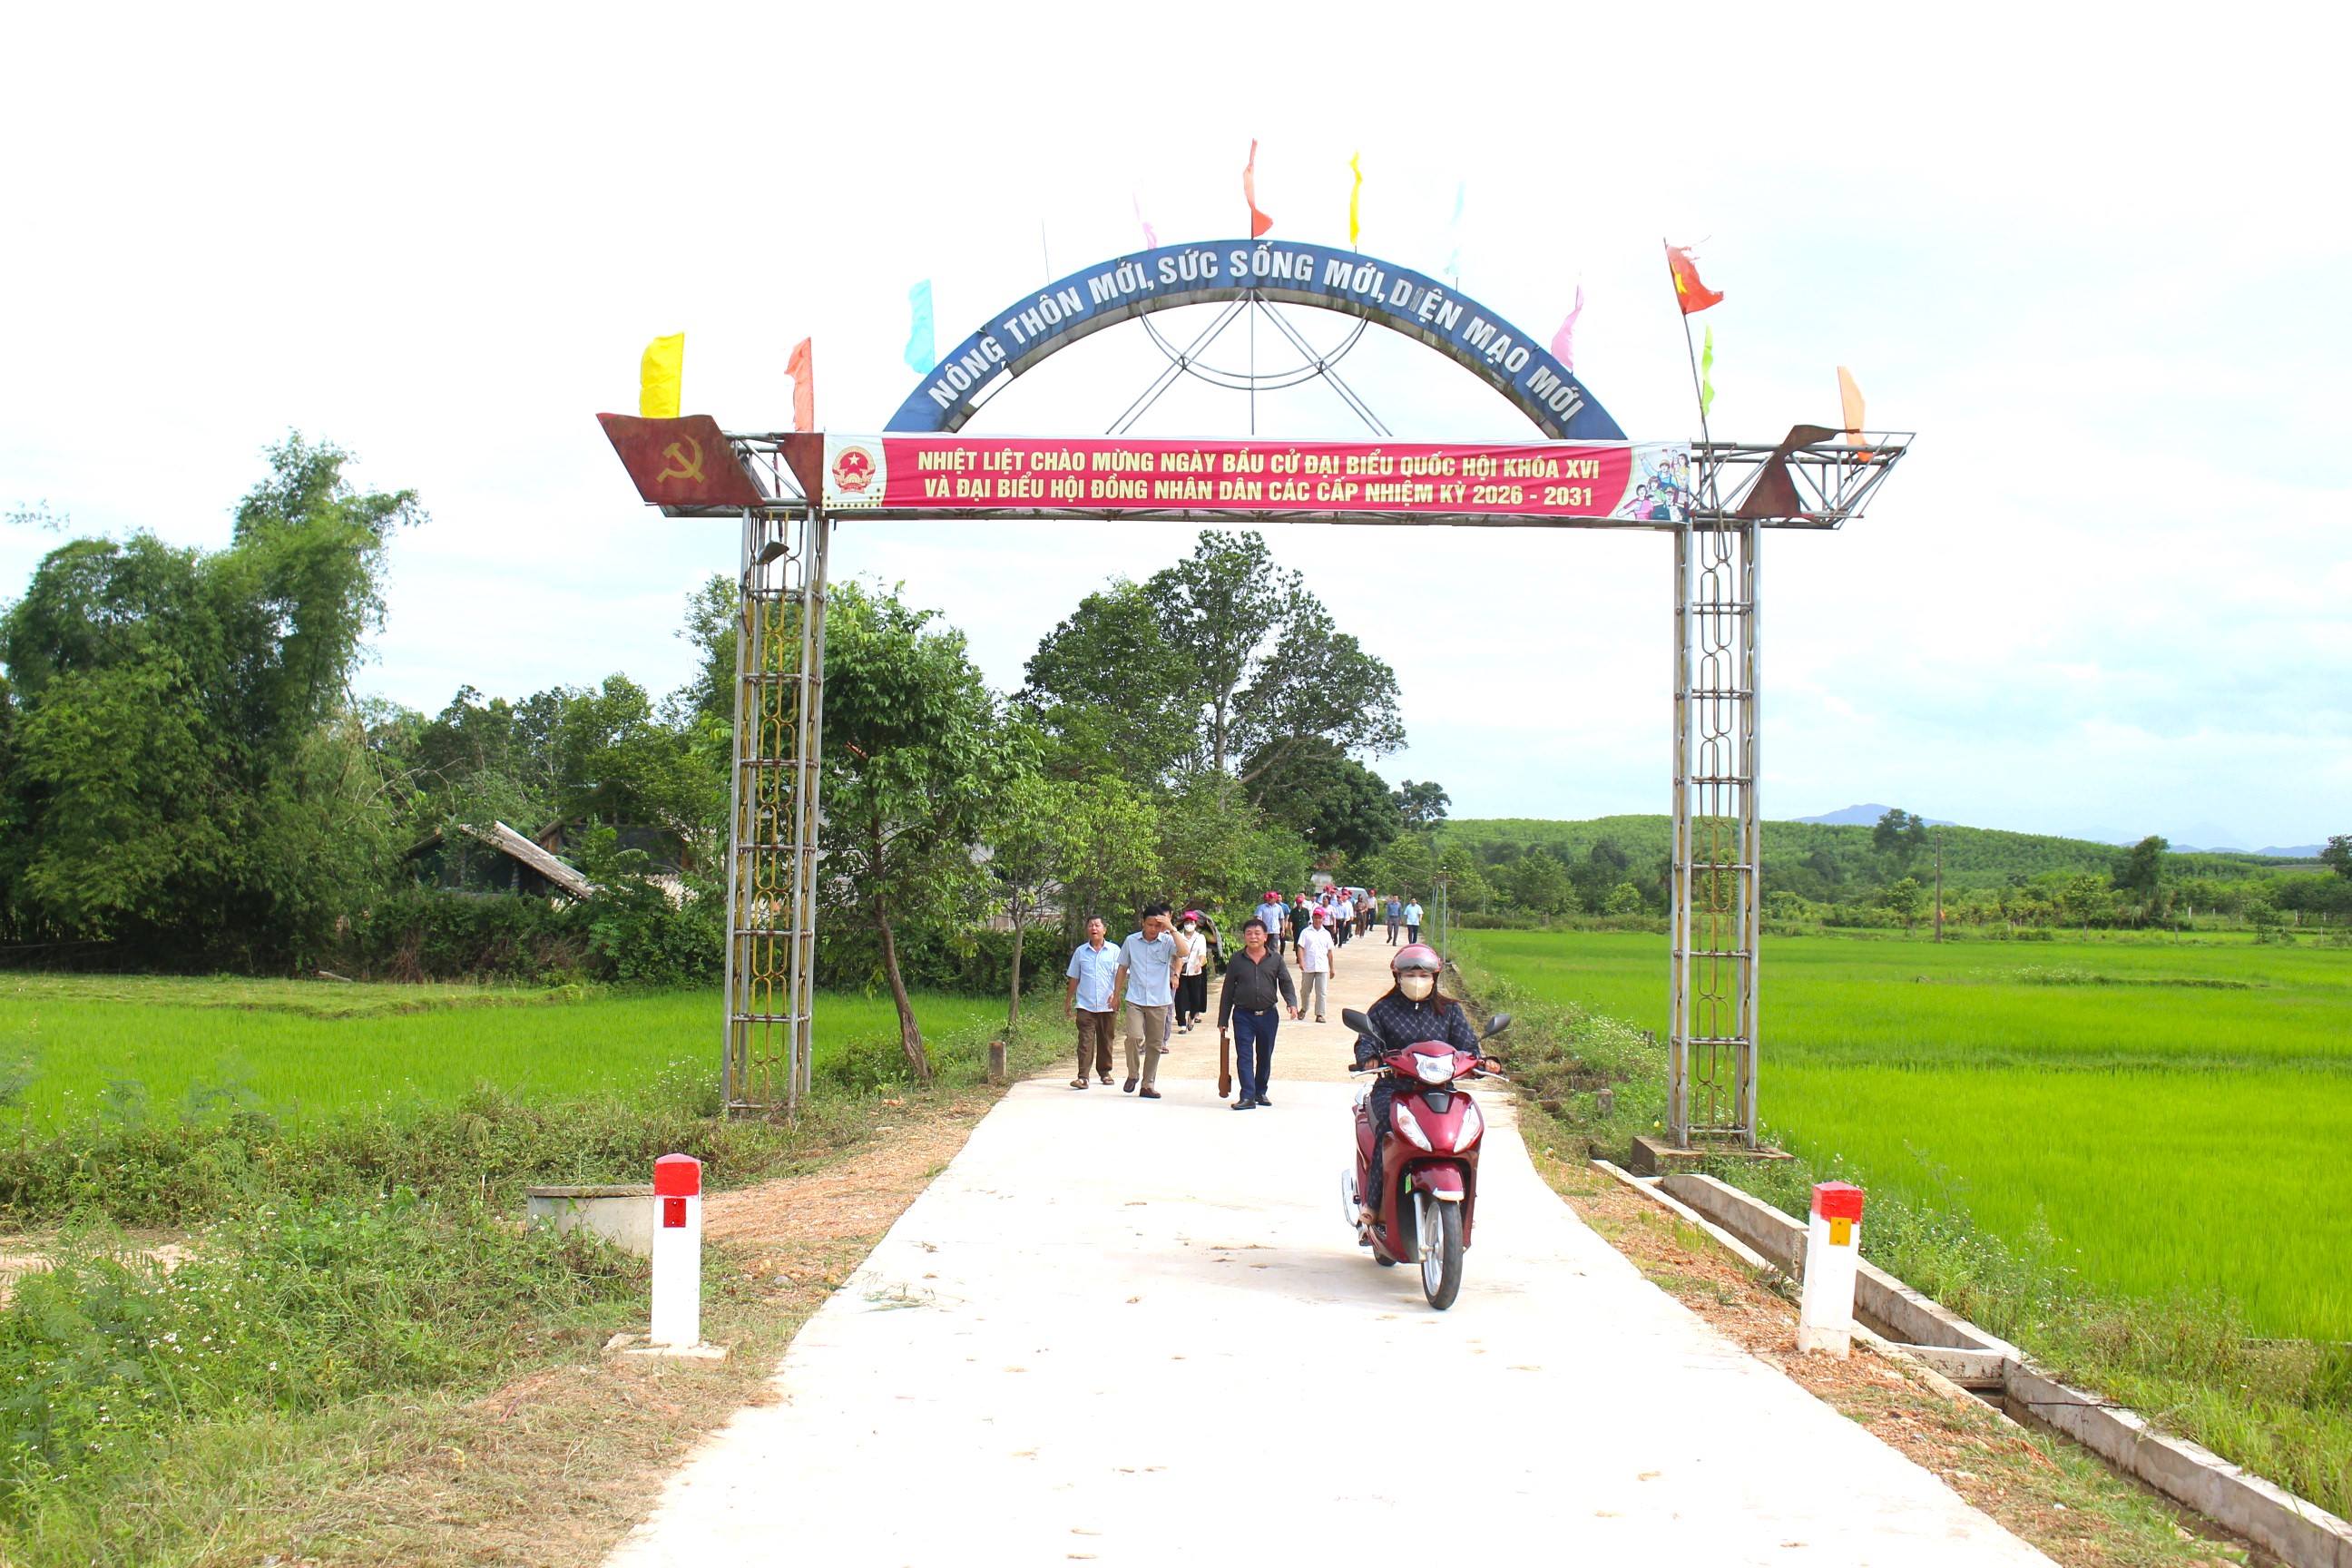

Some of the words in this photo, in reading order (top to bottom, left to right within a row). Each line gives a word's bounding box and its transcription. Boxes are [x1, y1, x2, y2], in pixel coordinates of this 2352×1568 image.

[927, 336, 1006, 409] NÔNG
[1004, 287, 1084, 345] THÔN
[1088, 258, 1154, 305] MỚI,
[1158, 248, 1218, 284] SỨC
[1230, 240, 1314, 281] SỐNG
[1323, 259, 1385, 302] MỚI,
[1389, 278, 1465, 331] DIỆN
[1463, 317, 1530, 373] MẠO
[1525, 365, 1584, 422] MỚI
[918, 447, 977, 475] NHIỆT
[983, 447, 1024, 475] LIỆT
[1031, 447, 1085, 471] CHÀO
[1092, 448, 1154, 472] MỪNG
[1161, 449, 1216, 473] NGÀY
[1222, 447, 1264, 473] BẦU
[1270, 448, 1301, 474] CỬ
[1305, 455, 1339, 478] ĐẠI
[1347, 448, 1394, 475] BIỂU
[1400, 450, 1455, 477] QUỐC
[1462, 455, 1497, 481] HỘI
[1504, 456, 1559, 478] KHÓA
[1565, 459, 1600, 479] XVI
[925, 475, 951, 497] VÀ
[956, 478, 991, 502] ĐẠI
[997, 471, 1044, 497] BIỂU
[1050, 475, 1084, 503] HỘI
[1091, 473, 1148, 498] ĐỒNG
[1154, 476, 1212, 500] NHÂN
[1219, 477, 1262, 501] DÂN
[1269, 478, 1310, 501] CÁC
[1317, 476, 1358, 501] CẤP
[1365, 480, 1433, 506] NHIỆM
[1439, 481, 1467, 504] KỲ
[1472, 485, 1524, 505] 2026
[1544, 486, 1592, 506] 2031
